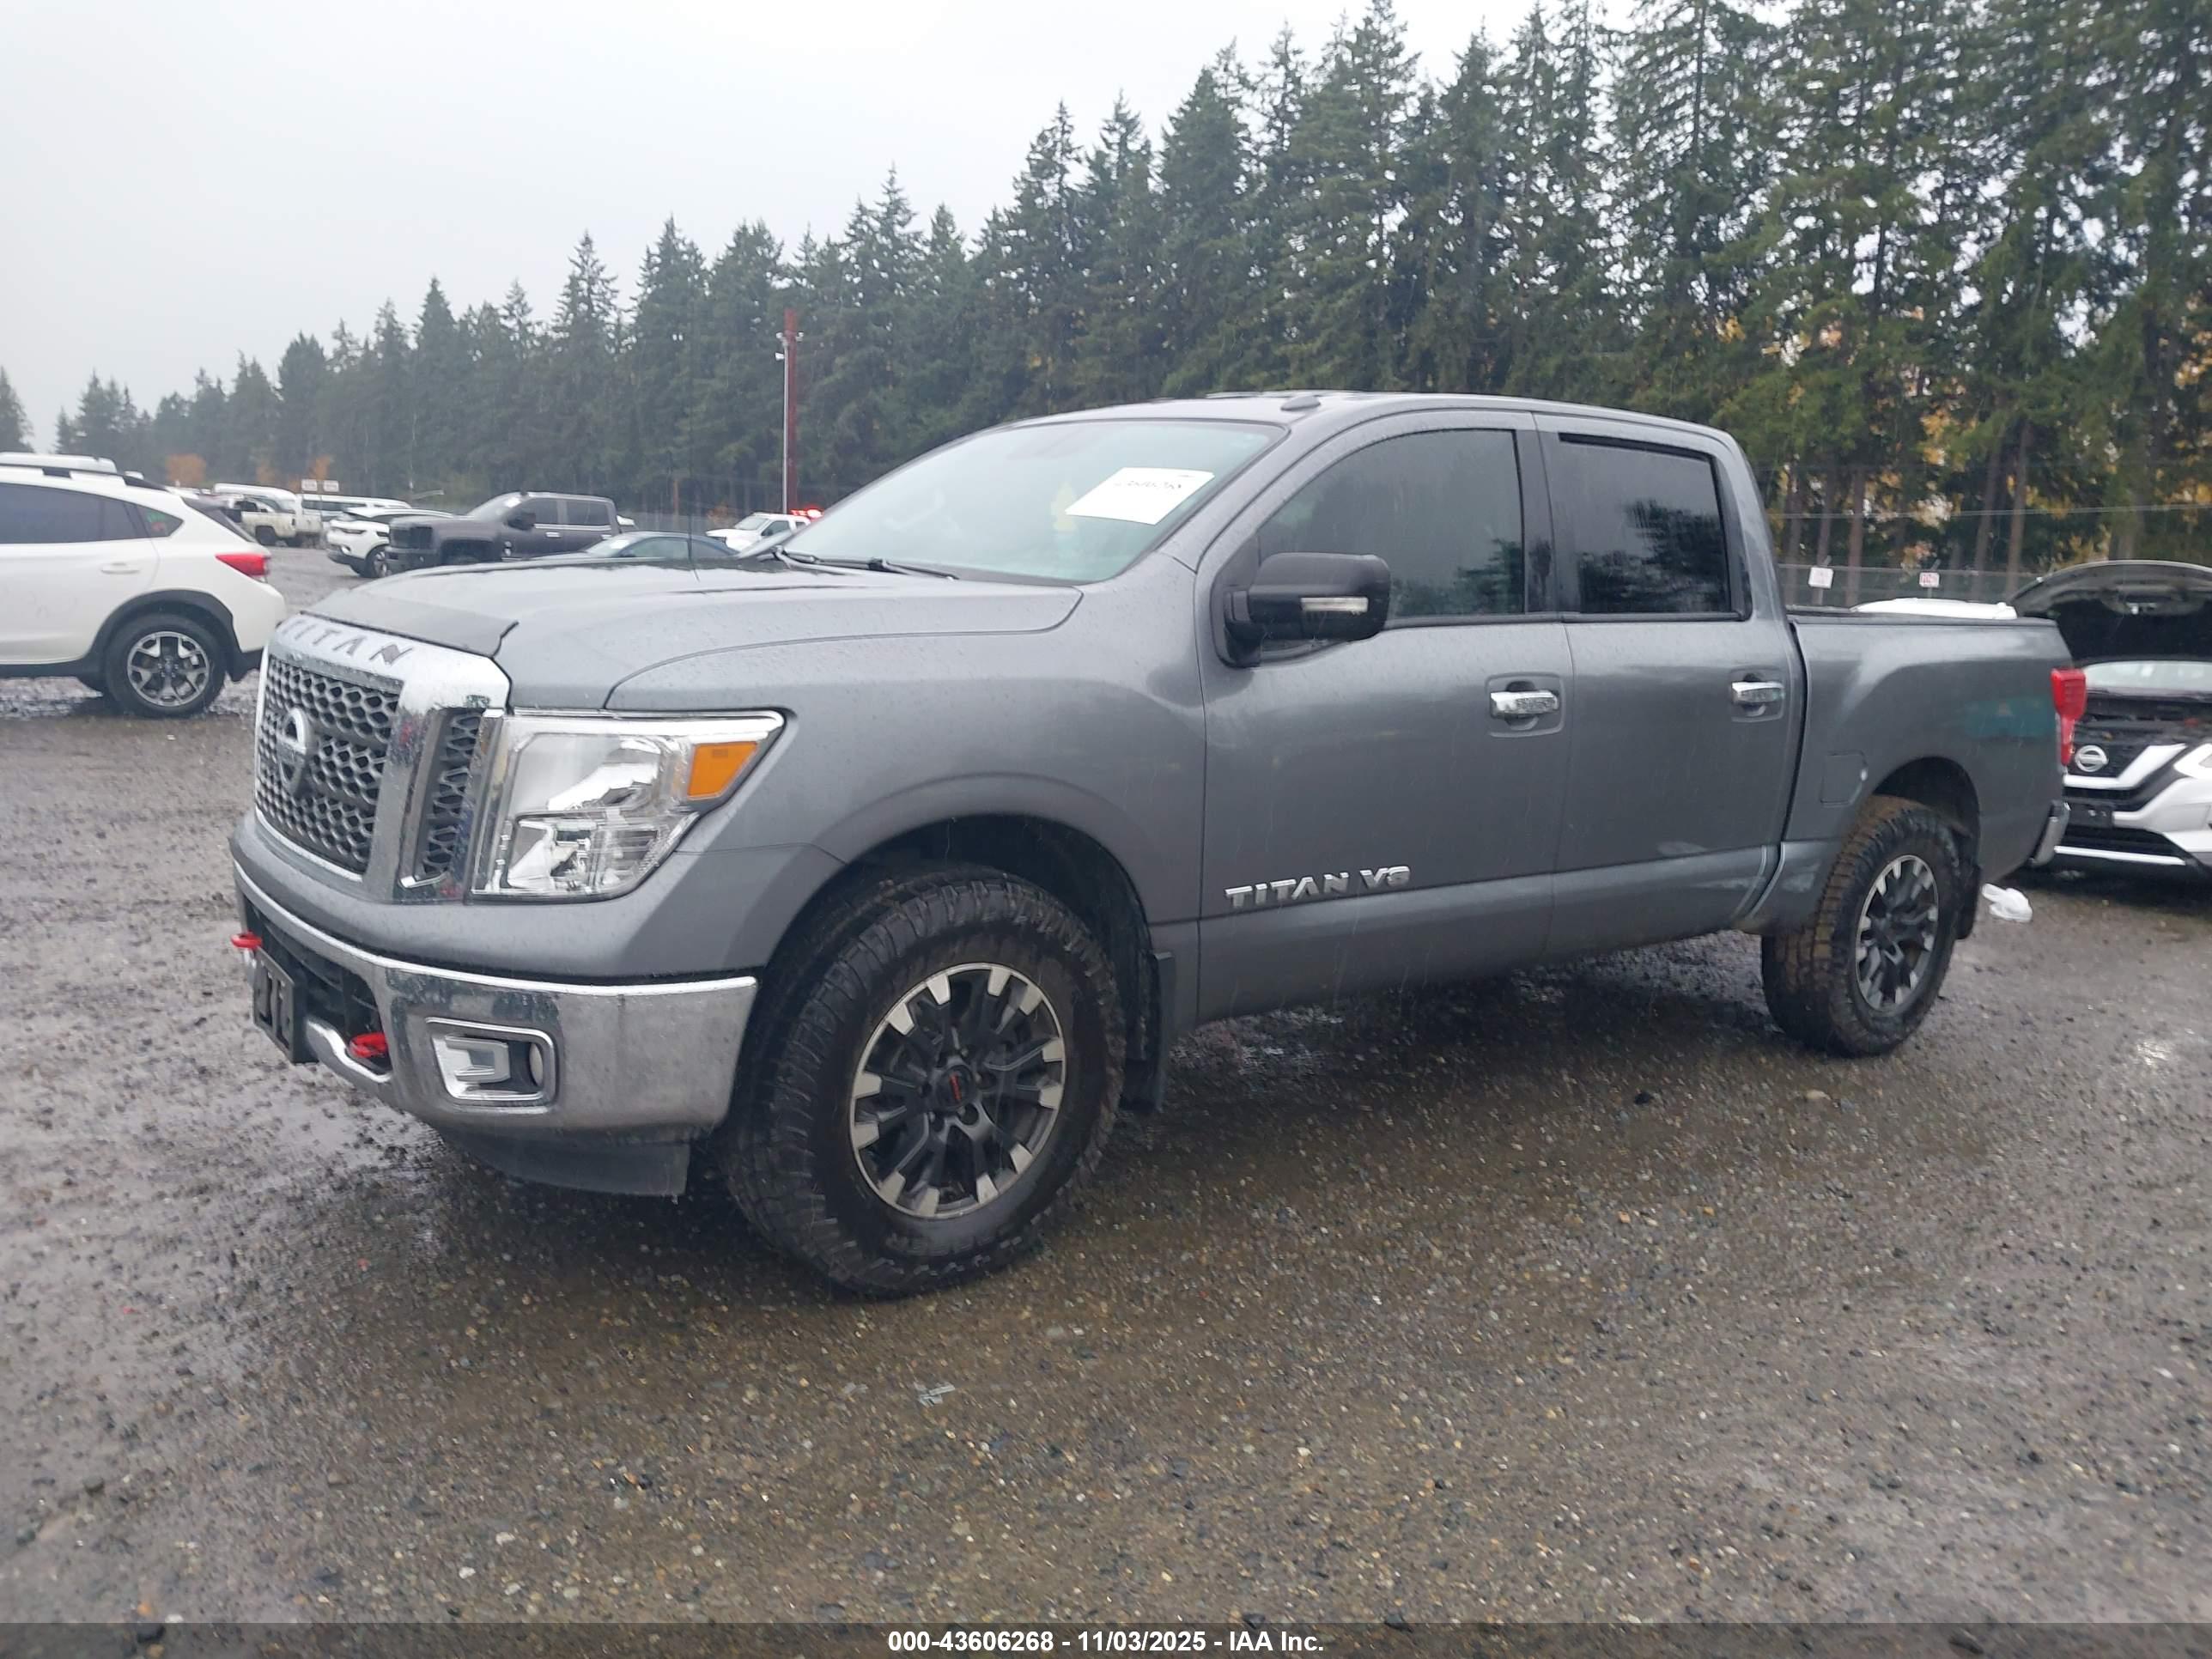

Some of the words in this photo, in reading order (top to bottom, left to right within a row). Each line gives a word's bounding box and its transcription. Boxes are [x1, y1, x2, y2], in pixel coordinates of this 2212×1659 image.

[281, 619, 413, 665] TITAN
[1224, 872, 1349, 908] TITAN
[1359, 866, 1411, 890] V8
